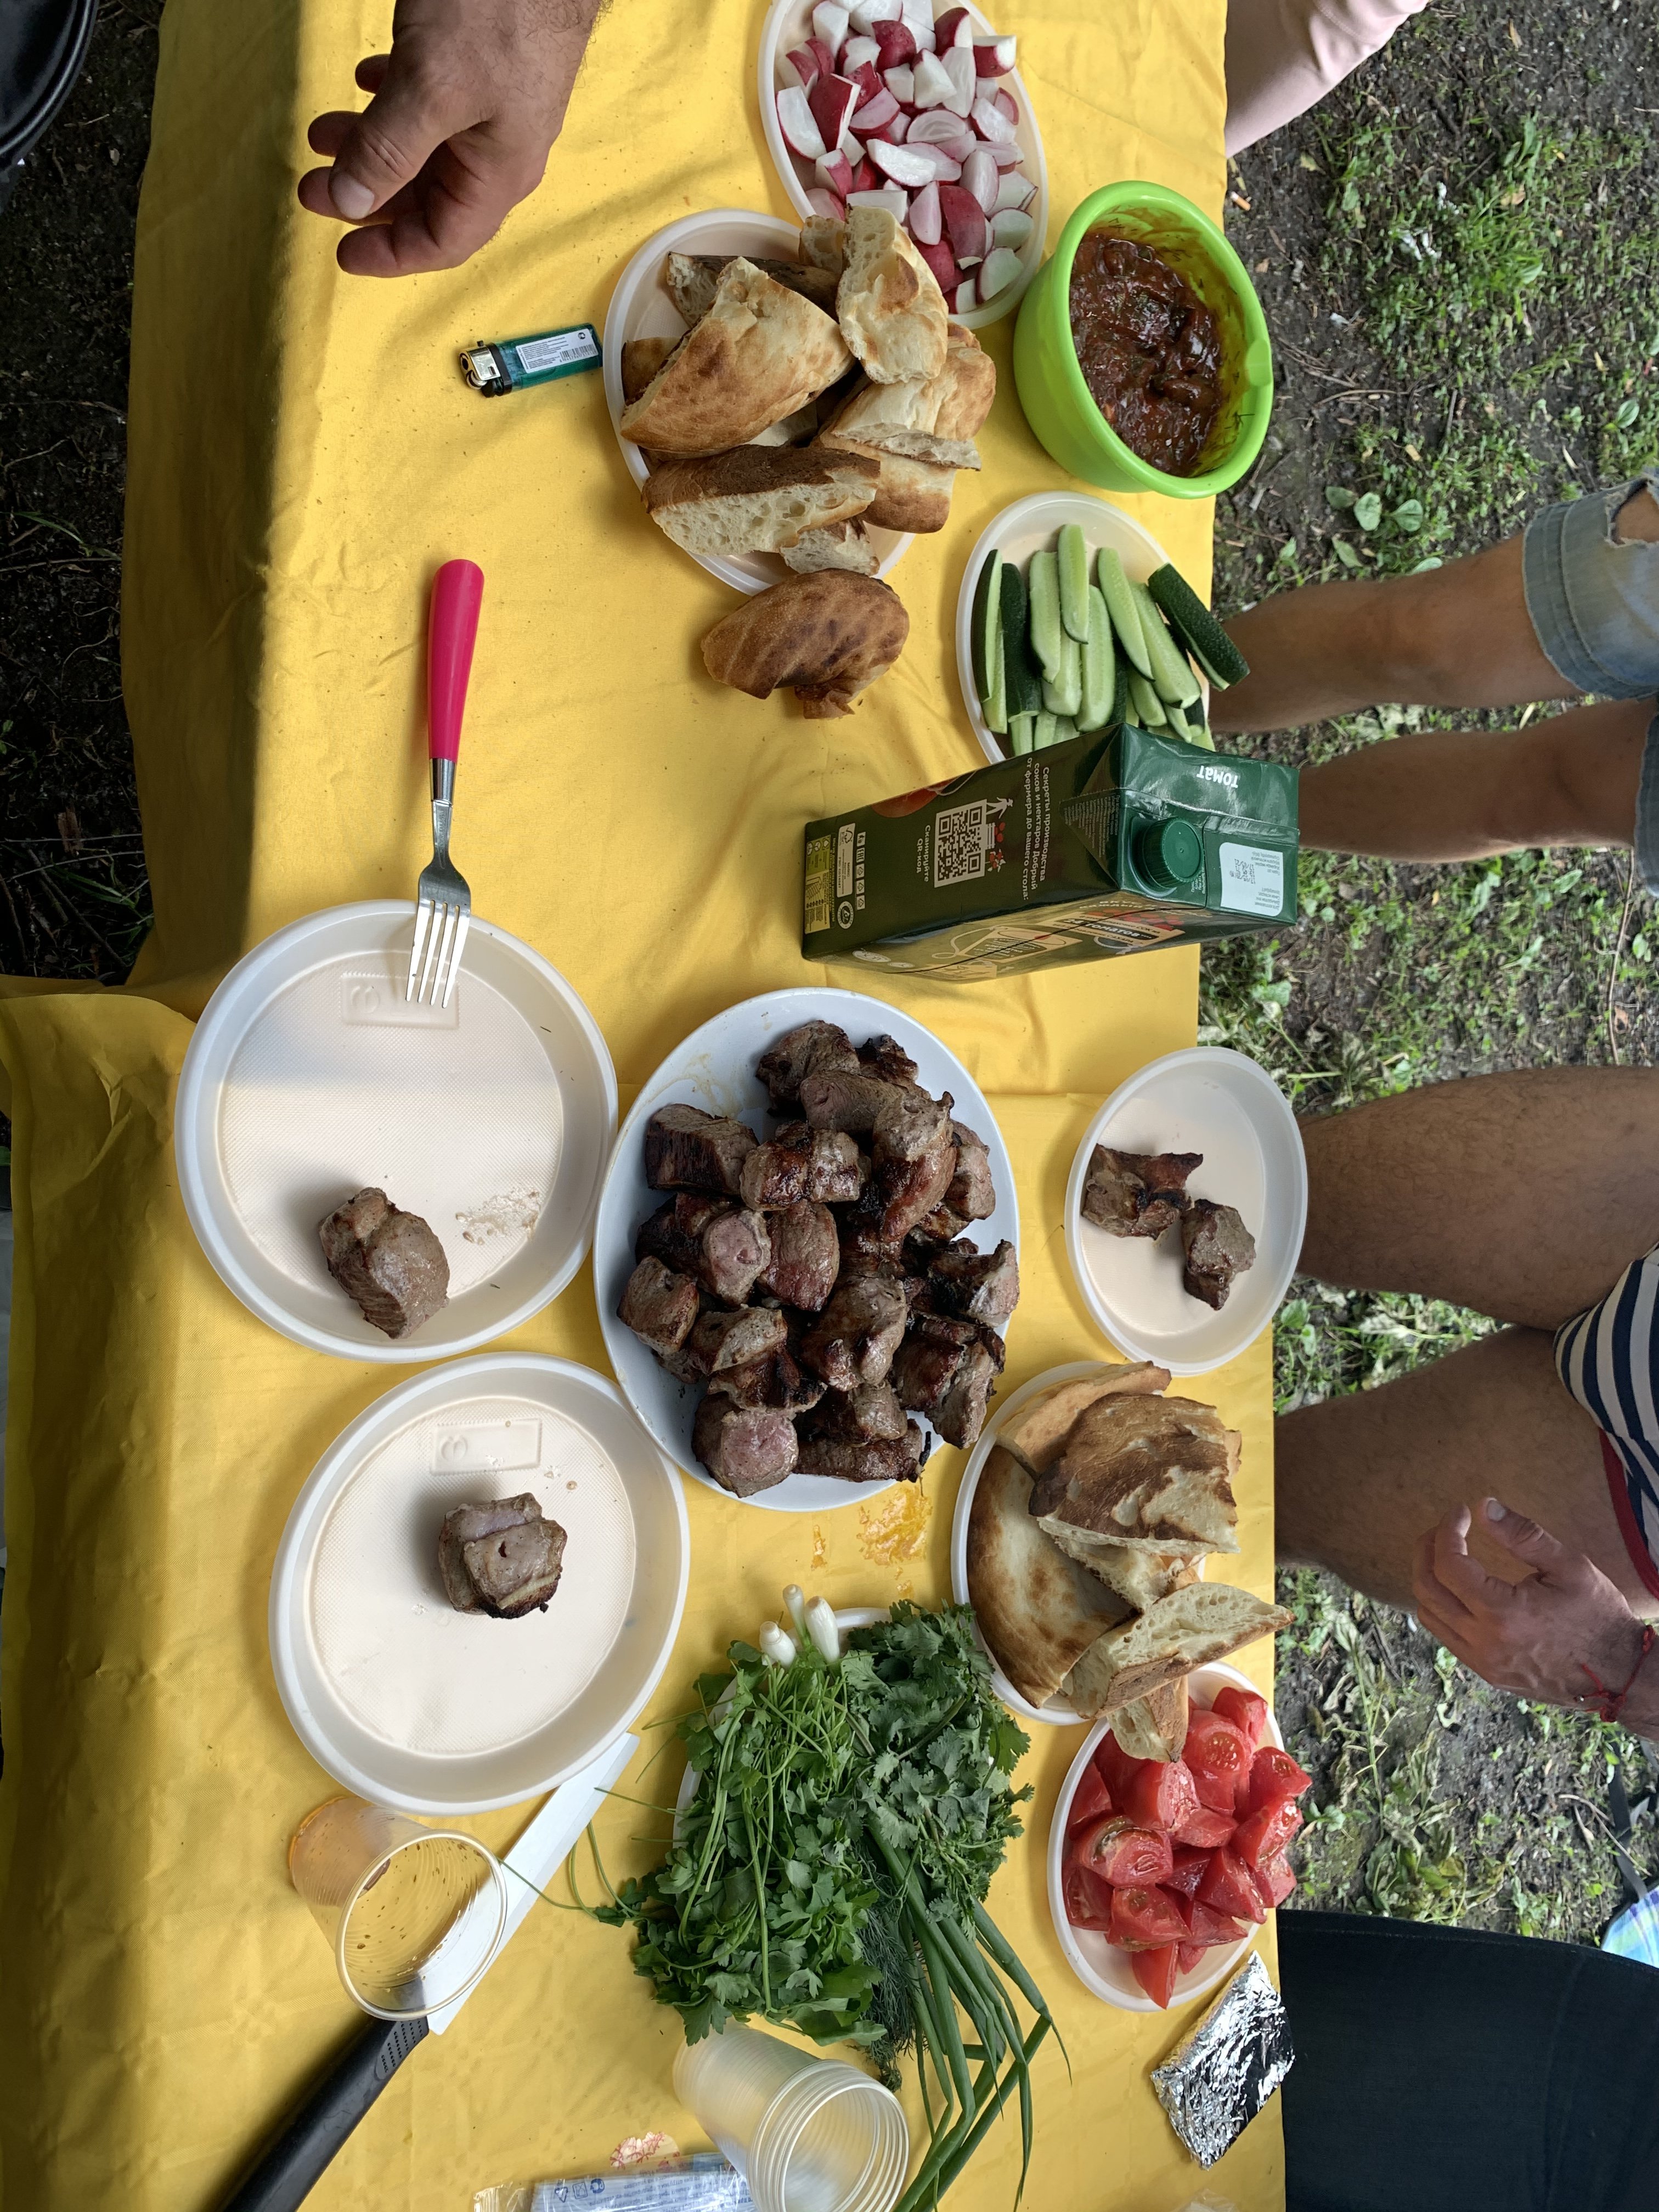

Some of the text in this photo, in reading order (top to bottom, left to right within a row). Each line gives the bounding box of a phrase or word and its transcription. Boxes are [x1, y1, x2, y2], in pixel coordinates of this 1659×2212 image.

[1026, 757, 1032, 768] от
[1196, 765, 1238, 788] томат
[1026, 817, 1032, 830] до
[923, 825, 931, 882] Сканируйте
[1024, 832, 1032, 866] вашего
[1040, 814, 1050, 882] производства
[1030, 851, 1040, 890] Добрый
